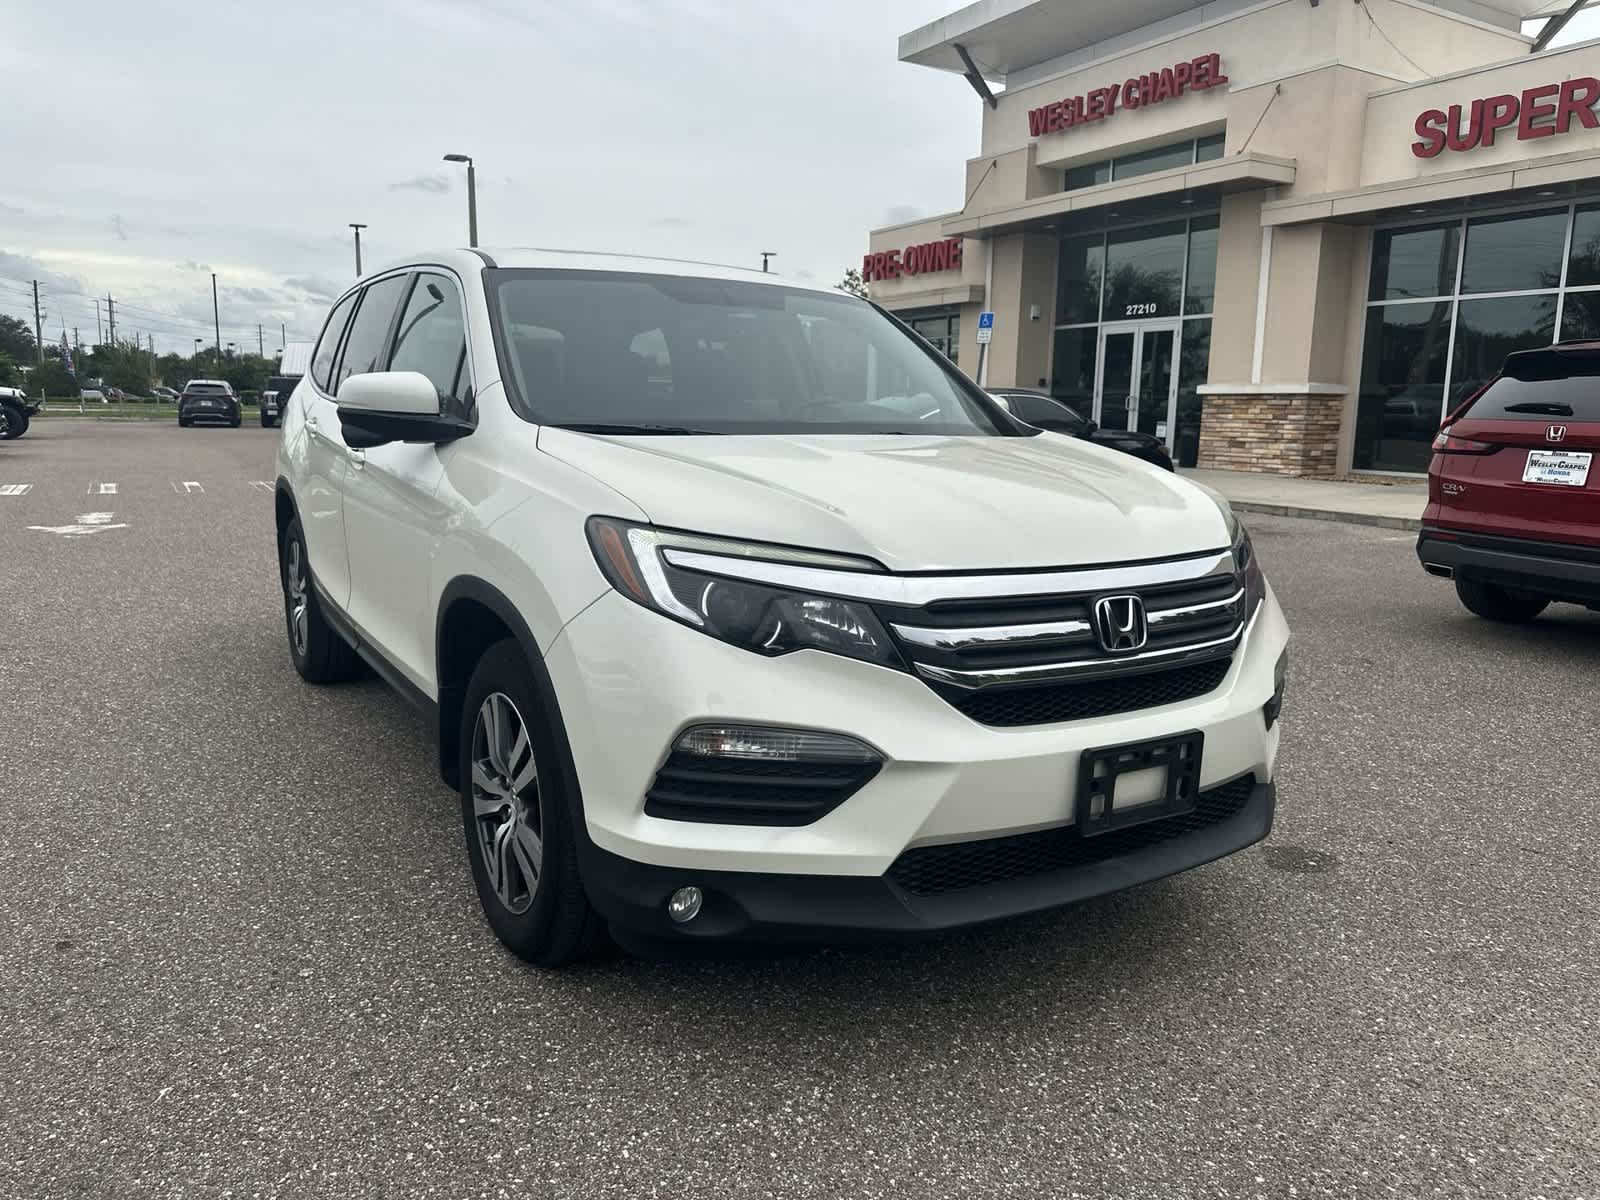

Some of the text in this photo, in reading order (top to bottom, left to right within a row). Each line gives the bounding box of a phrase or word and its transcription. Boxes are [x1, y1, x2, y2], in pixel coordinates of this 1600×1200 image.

[1027, 53, 1229, 137] WESLEY CHAPEL
[1411, 77, 1600, 158] SUPER
[1125, 303, 1157, 316] 27210
